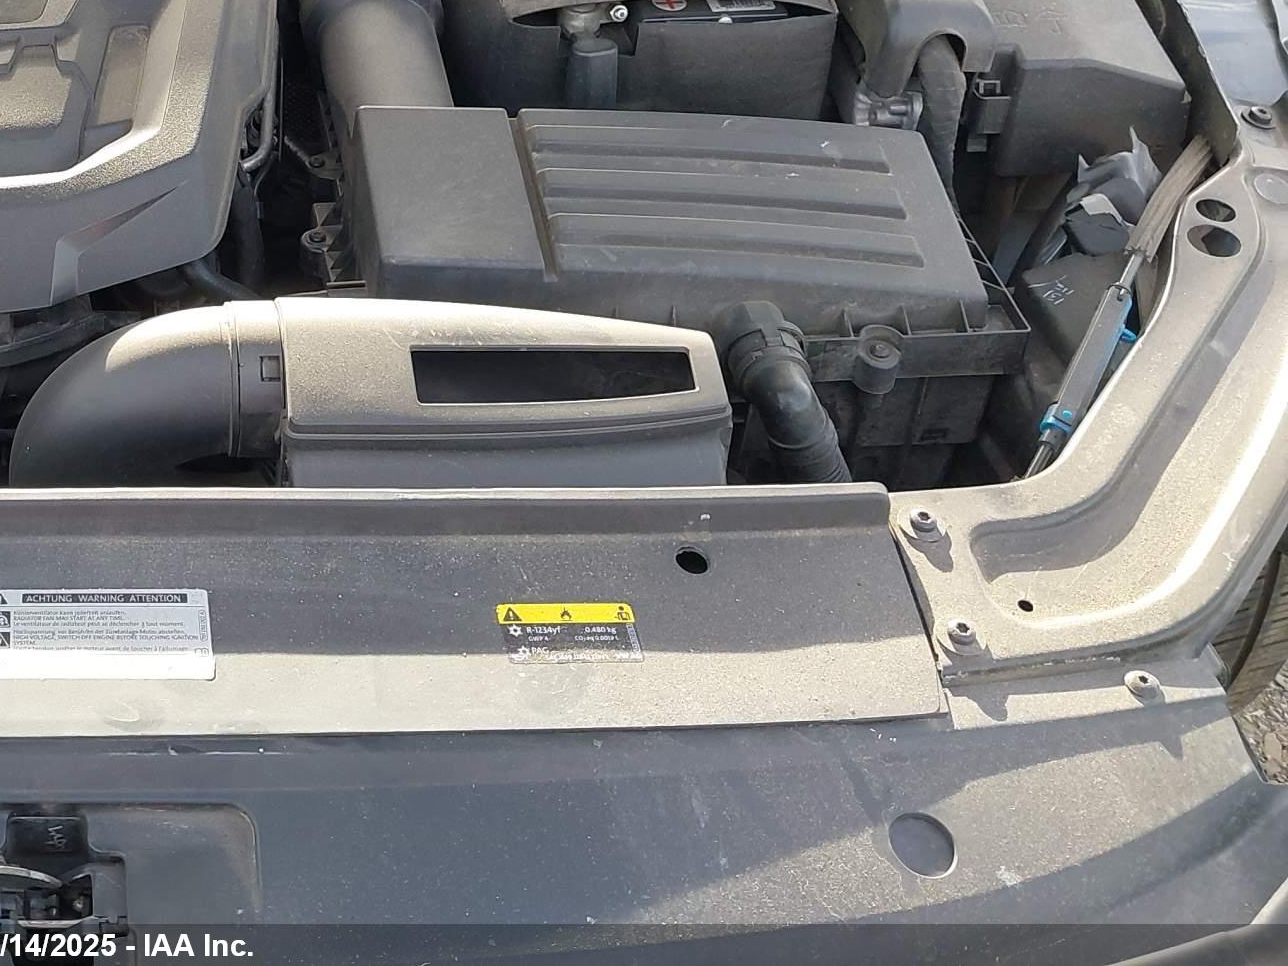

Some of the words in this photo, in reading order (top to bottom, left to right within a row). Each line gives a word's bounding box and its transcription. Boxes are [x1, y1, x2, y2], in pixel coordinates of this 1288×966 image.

[26, 594, 72, 602] ACHTUNG
[78, 594, 124, 602] WARNING
[128, 594, 181, 602] ATTENTION
[526, 626, 561, 634] R-1234yf
[531, 646, 549, 654] PAG
